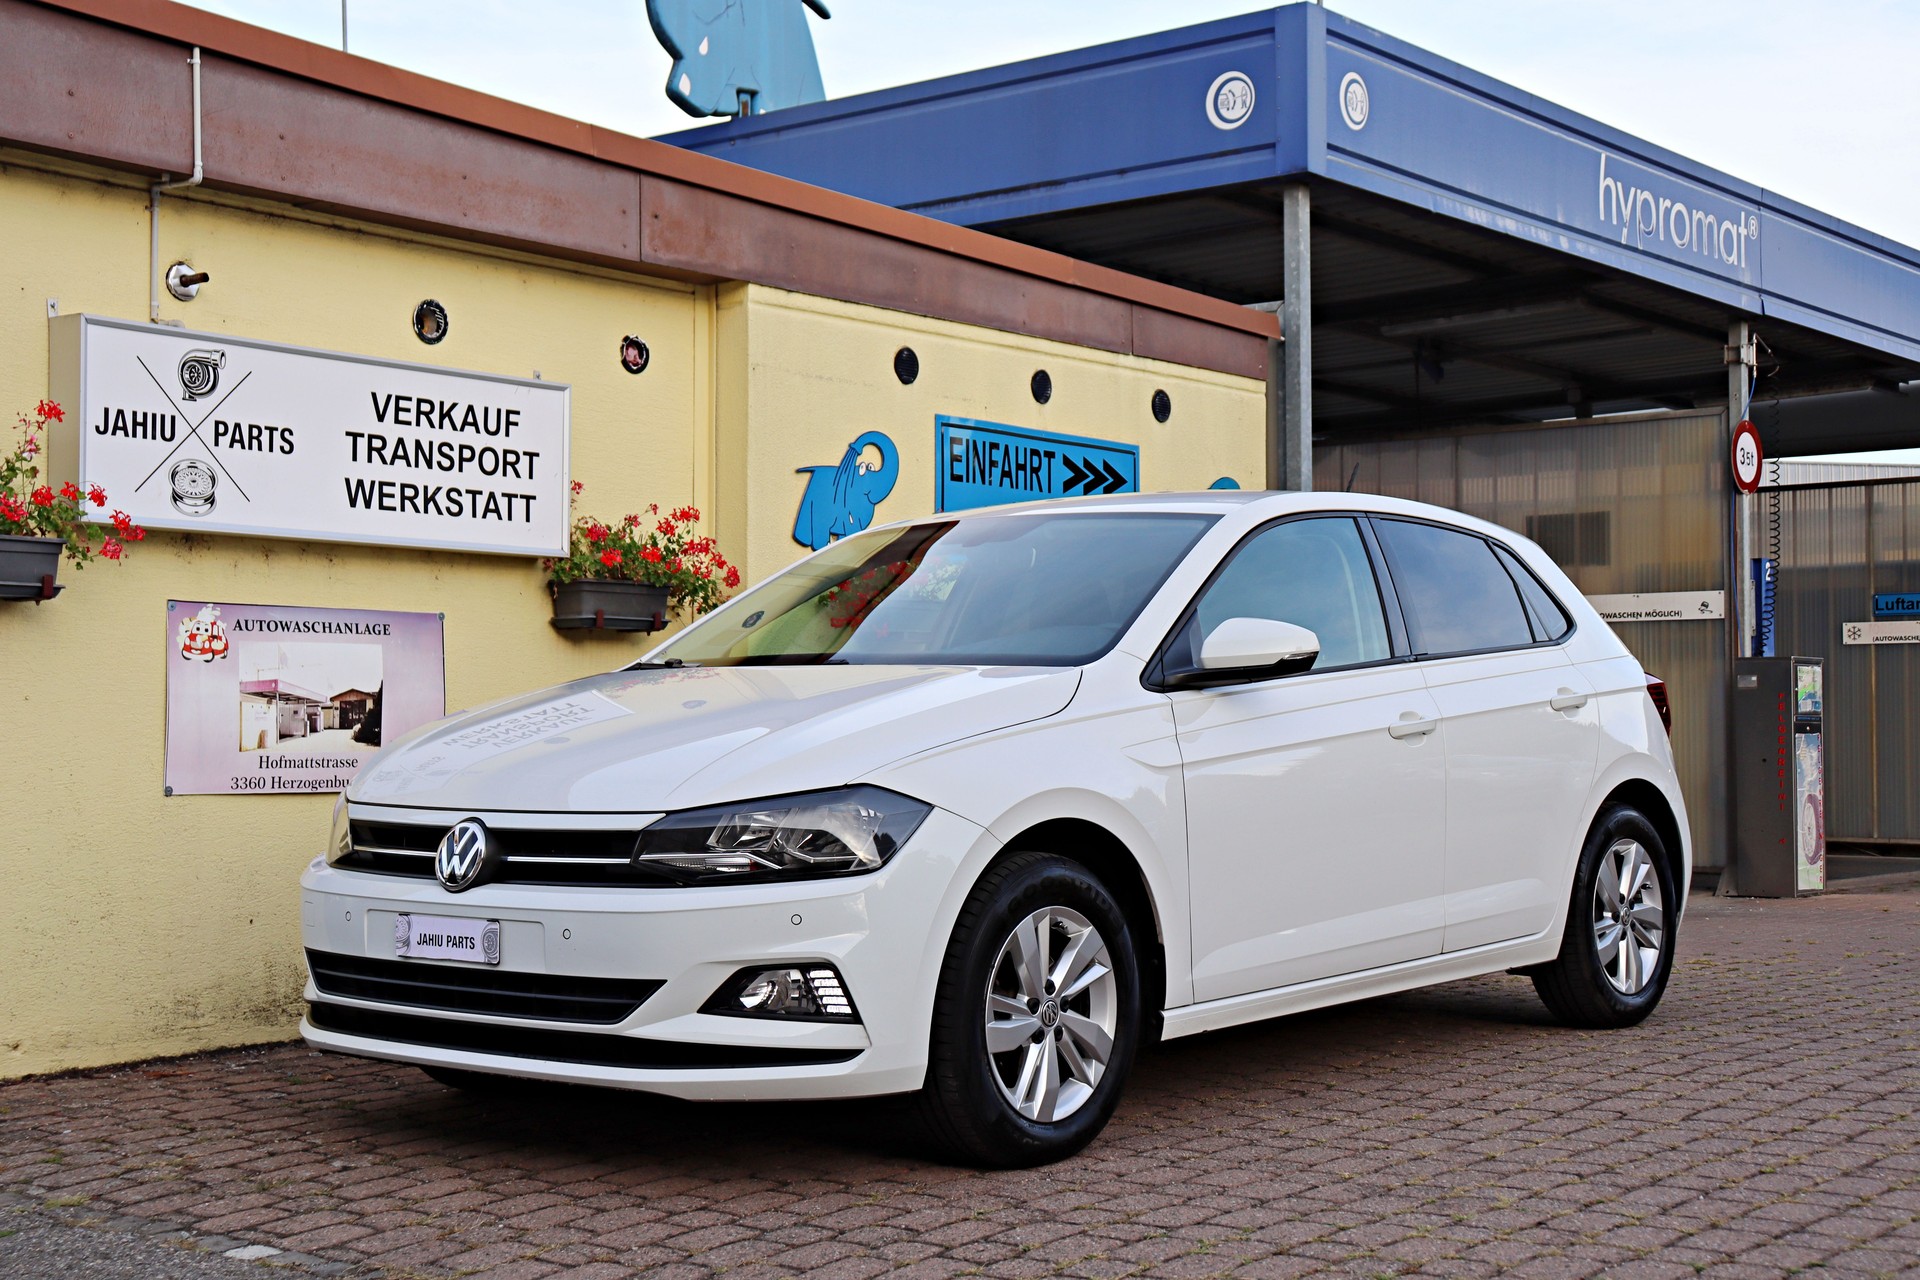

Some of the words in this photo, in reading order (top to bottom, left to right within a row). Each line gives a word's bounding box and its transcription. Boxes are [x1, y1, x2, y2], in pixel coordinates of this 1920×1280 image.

[95, 407, 176, 442] JAHIU
[213, 420, 295, 455] PARTS
[370, 391, 521, 438] VERKAUF
[345, 431, 540, 480] TRANSPORT
[950, 436, 1056, 494] EINFAHRT
[344, 477, 537, 523] WERKSTATT
[232, 618, 391, 636] AUTOWASCHANLAGE
[230, 777, 266, 790] 3360
[258, 755, 359, 769] Hofmattstrasse
[416, 932, 443, 947] JAHIU
[446, 935, 476, 950] PARTS
